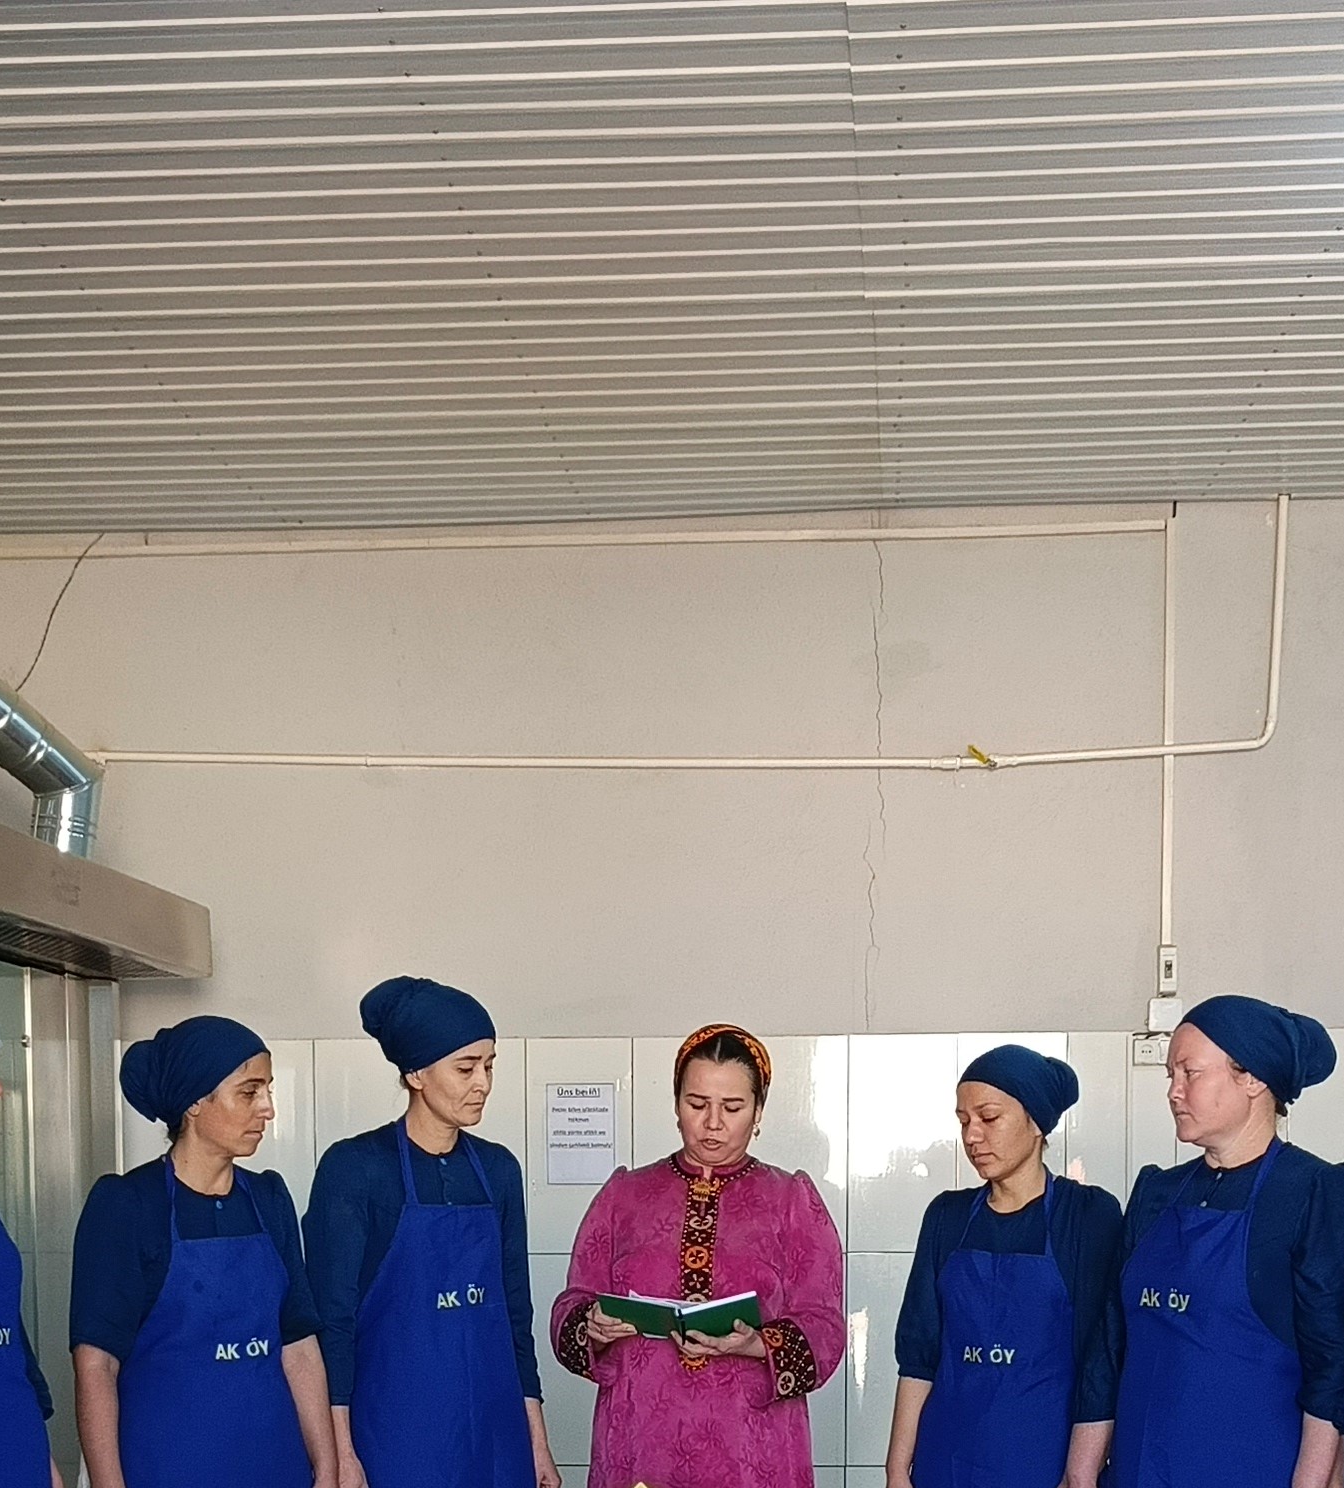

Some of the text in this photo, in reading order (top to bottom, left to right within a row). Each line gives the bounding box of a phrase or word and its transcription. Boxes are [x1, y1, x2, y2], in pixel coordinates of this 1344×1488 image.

[437, 1283, 485, 1309] AK ÖY
[215, 1343, 240, 1360] AK
[963, 1343, 1015, 1364] AK ÖY
